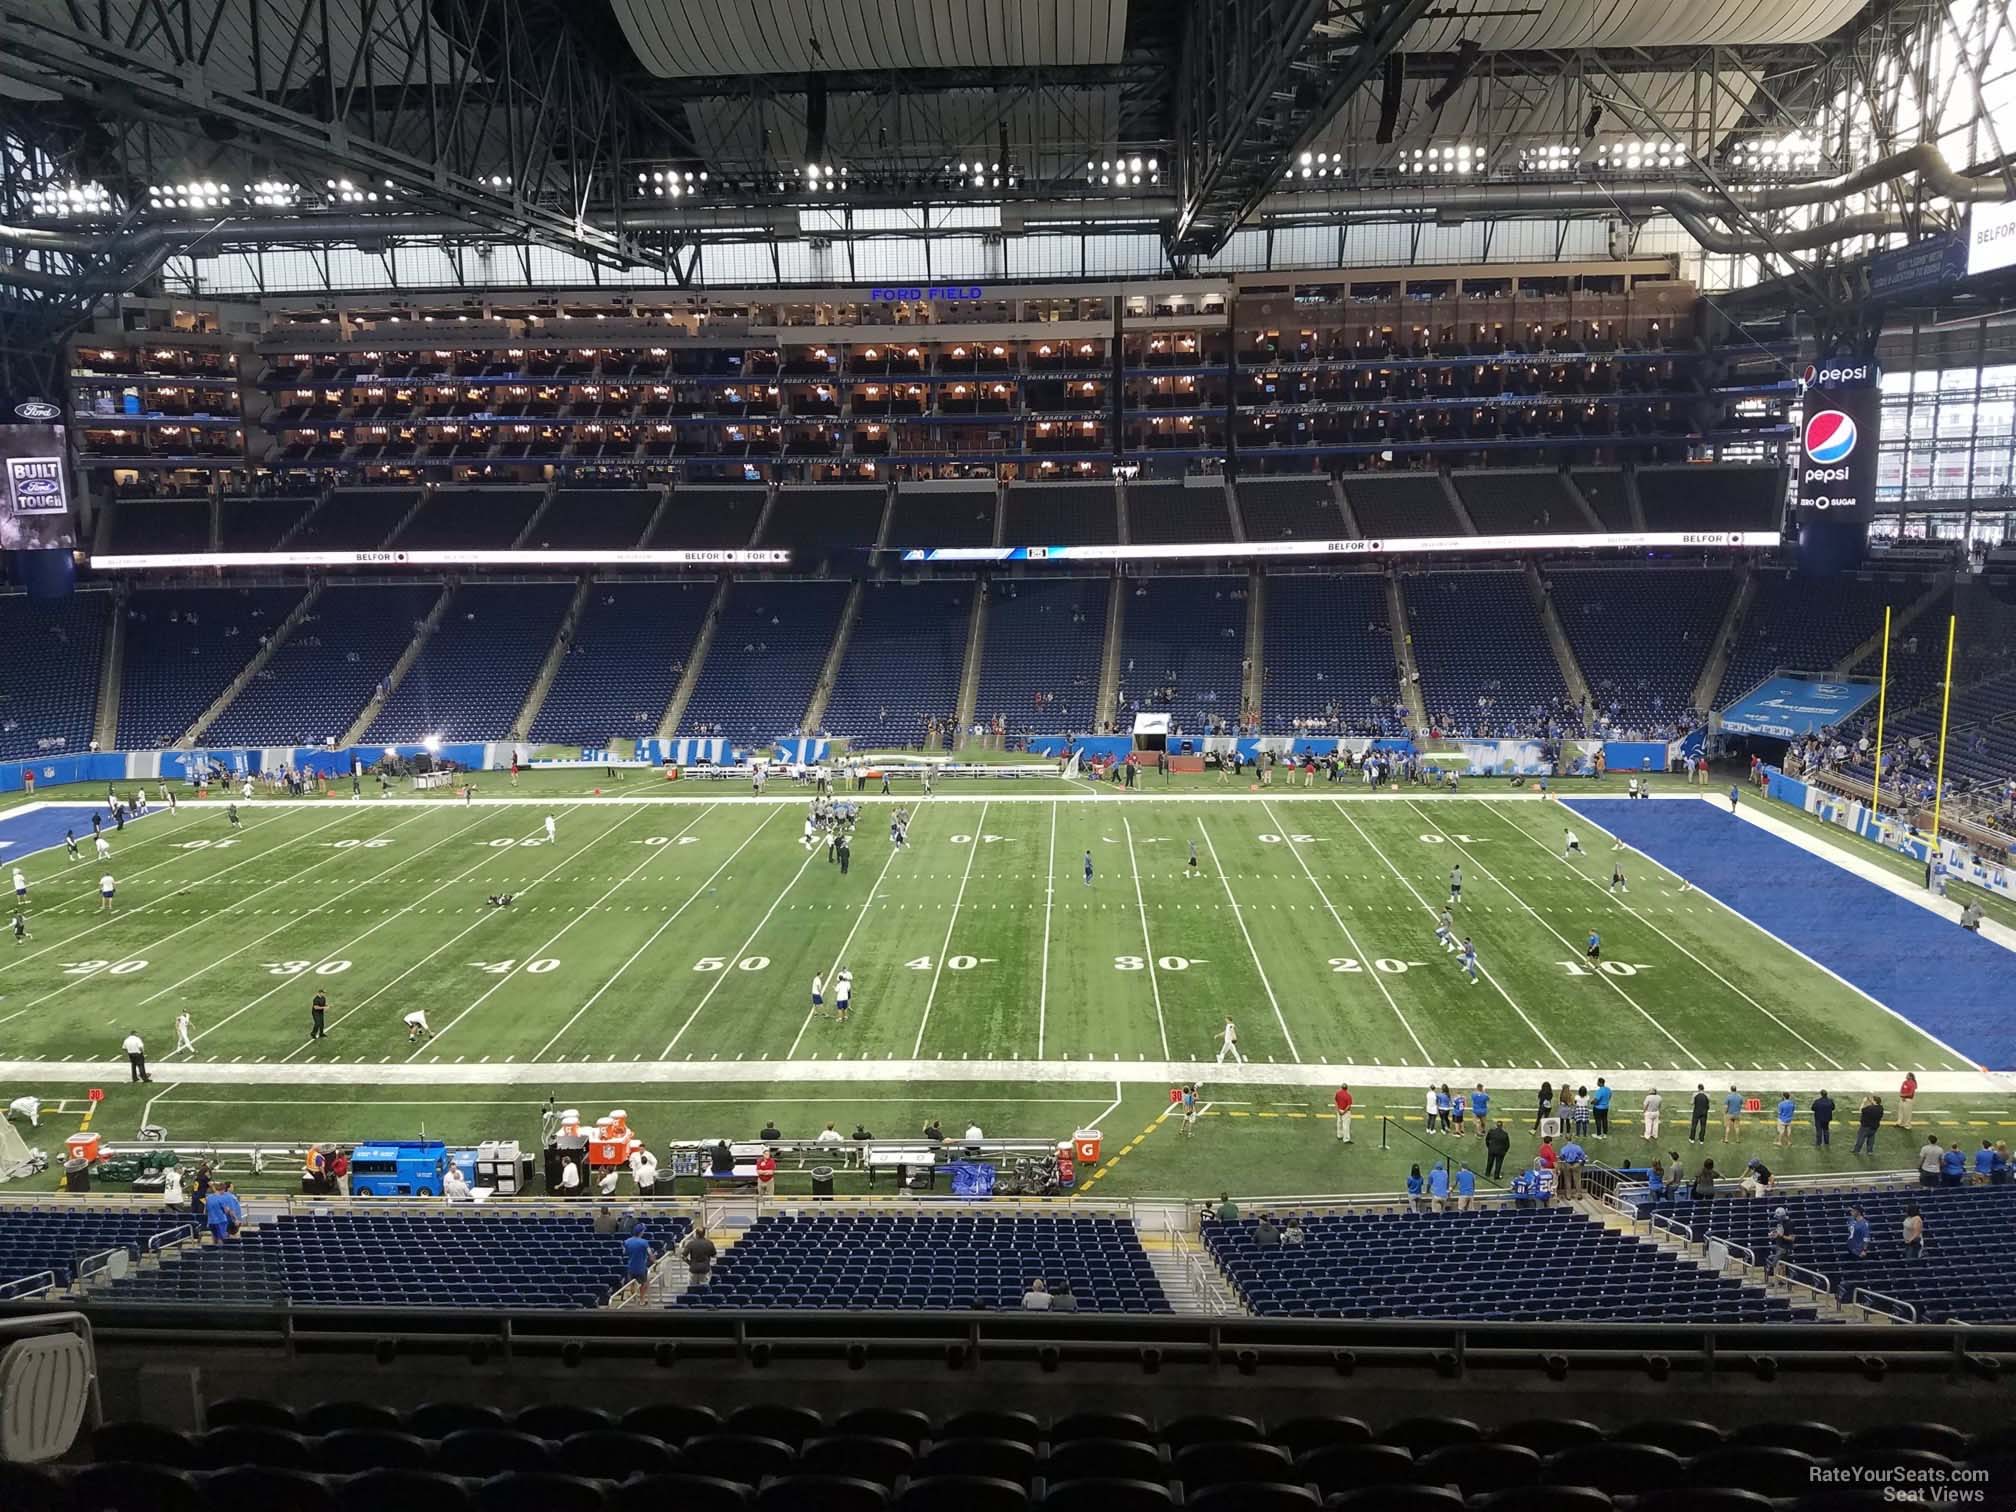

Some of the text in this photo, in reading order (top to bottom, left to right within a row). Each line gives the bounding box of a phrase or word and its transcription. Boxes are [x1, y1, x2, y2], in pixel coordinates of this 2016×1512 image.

[1977, 222, 2016, 245] BELFOR
[872, 287, 982, 301] FORD FIELD
[1819, 365, 1866, 384] pepsi
[23, 405, 52, 417] Ford
[14, 464, 57, 479] BUILT
[1805, 466, 1849, 484] pepsi
[27, 482, 51, 493] Ford
[18, 495, 62, 509] TOUGH
[1831, 497, 1856, 506] SUGAR
[1328, 541, 1365, 550] BELFOR
[1683, 535, 1723, 543] BELFOR
[356, 552, 391, 561] BELFOR
[684, 552, 720, 560] BELFOR
[746, 552, 765, 560] FOR
[63, 959, 150, 975] 20
[269, 959, 353, 975] 30
[482, 958, 561, 974] 40
[693, 956, 771, 971] 50
[904, 955, 978, 970] 40
[1114, 955, 1190, 971] 30
[1328, 957, 1409, 974] 20
[1556, 959, 1637, 977] 10
[1171, 1090, 1182, 1102] 30
[1748, 1099, 1760, 1111] 10
[73, 1146, 84, 1158] G
[1082, 1143, 1094, 1155] G
